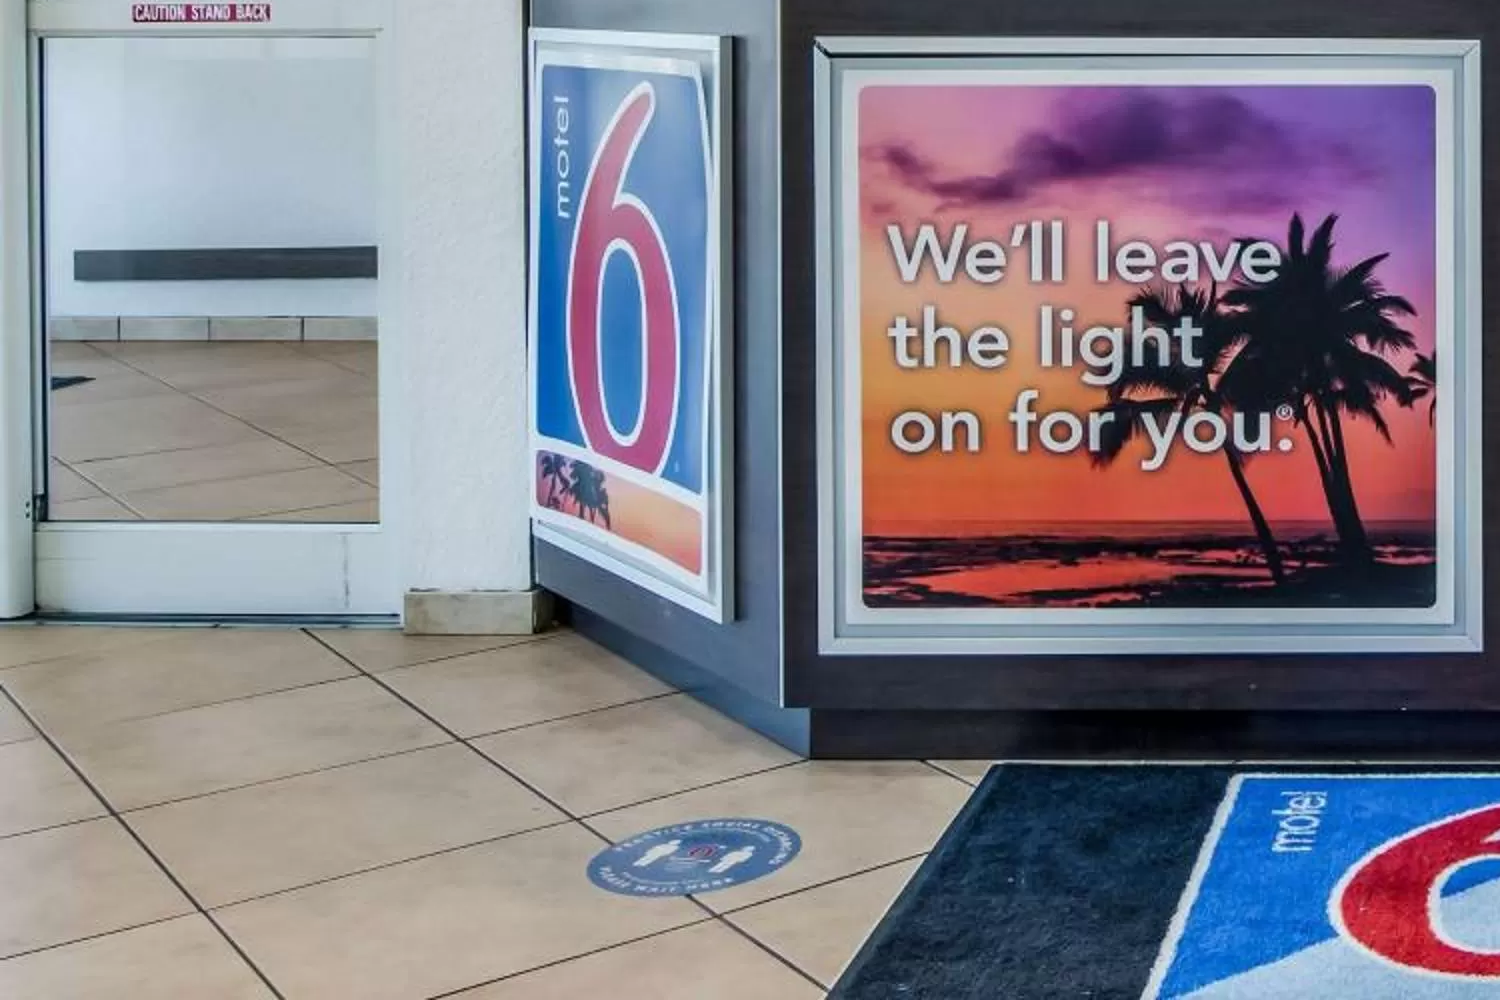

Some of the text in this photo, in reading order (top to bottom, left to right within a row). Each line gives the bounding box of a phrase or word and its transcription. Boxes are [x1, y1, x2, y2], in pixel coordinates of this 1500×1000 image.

[135, 4, 267, 21] CAUTION STAND BACK
[556, 96, 572, 219] motel
[565, 80, 681, 477] 6
[887, 219, 1282, 283] We'll leave
[887, 305, 1204, 386] the light
[890, 409, 981, 453] on
[1008, 389, 1115, 453] for
[1271, 790, 1328, 853] motel
